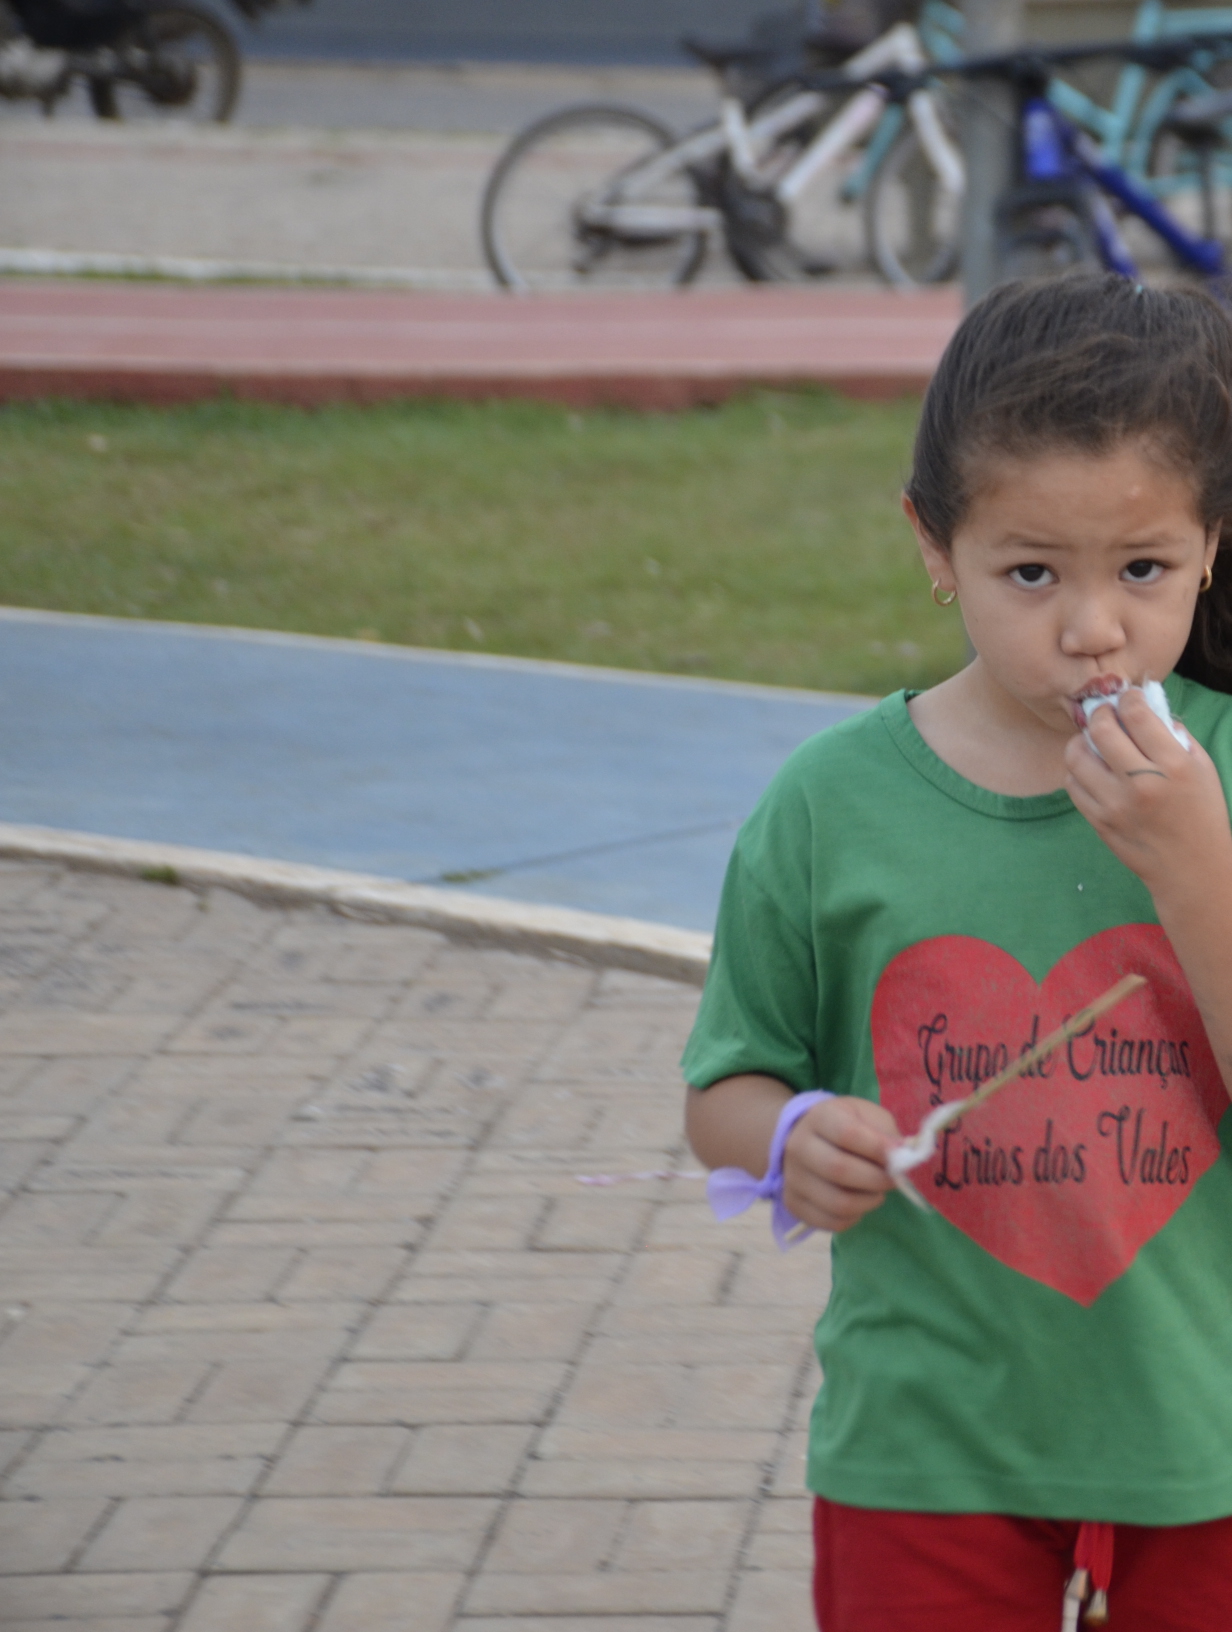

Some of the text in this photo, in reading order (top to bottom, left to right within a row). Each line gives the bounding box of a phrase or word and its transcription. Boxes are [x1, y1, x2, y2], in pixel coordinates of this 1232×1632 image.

[918, 1009, 1192, 1105] Grupo de Crianças
[1032, 1118, 1088, 1184] dos
[1097, 1105, 1192, 1186] Vales
